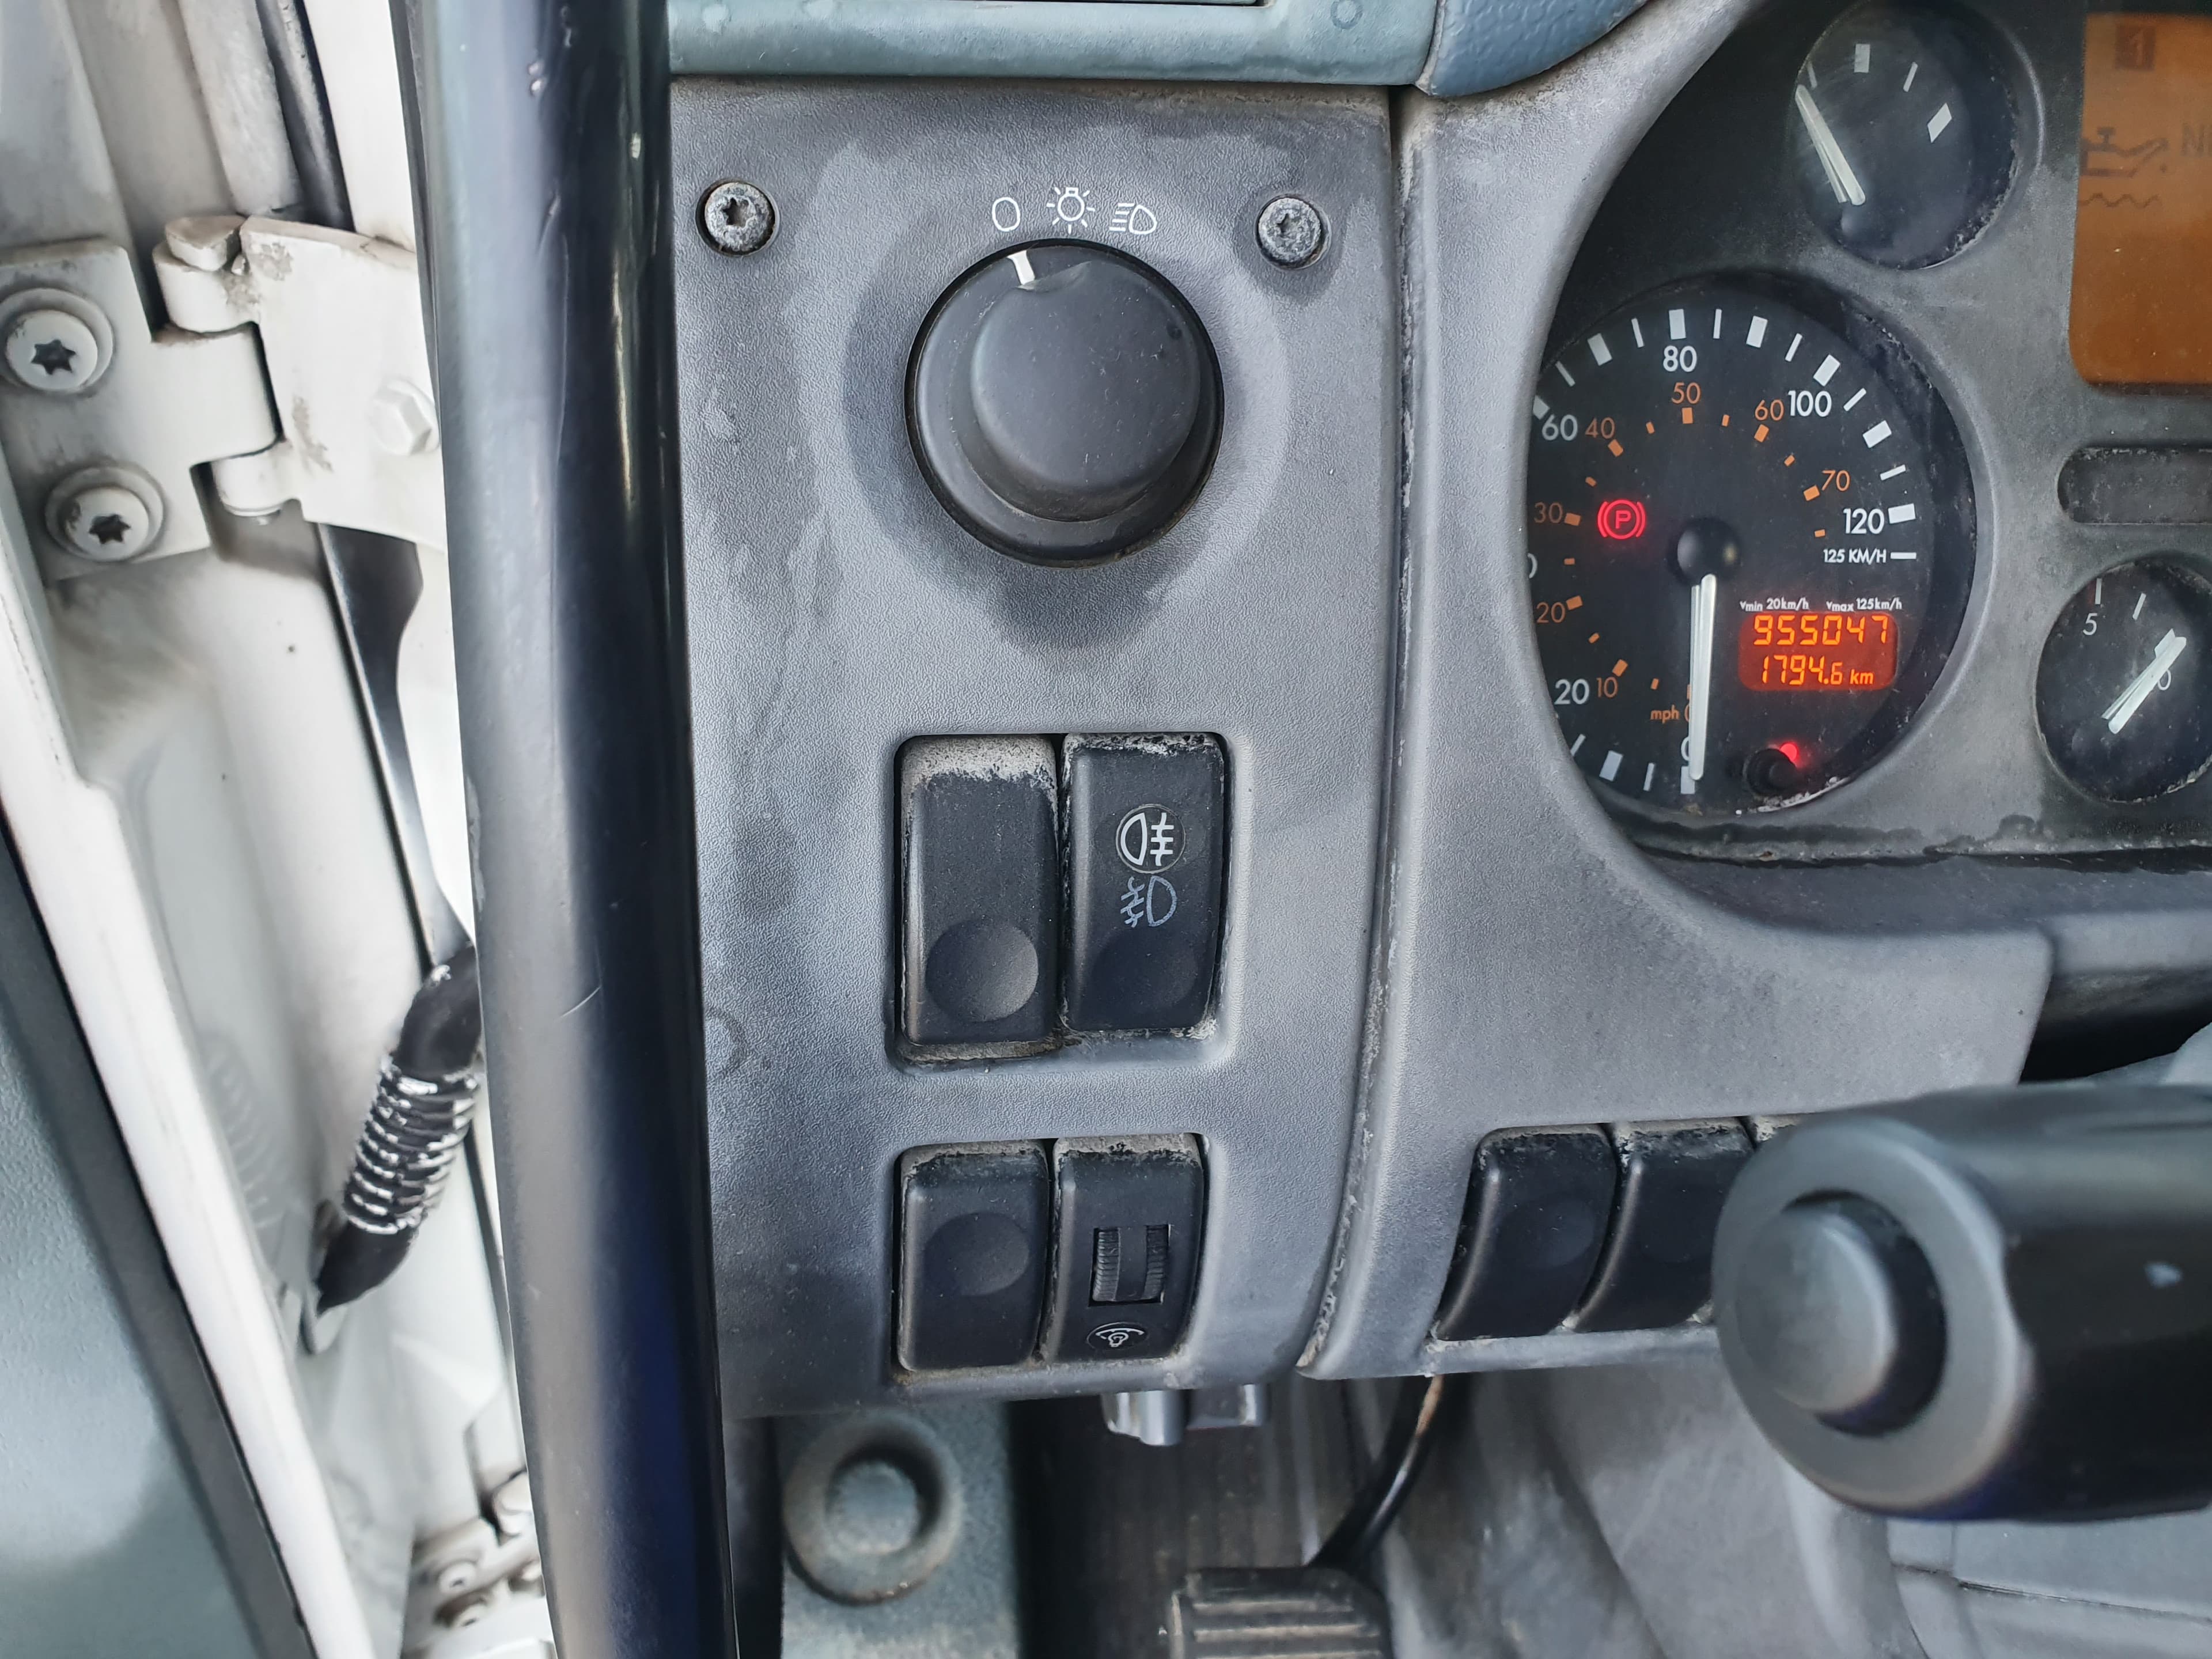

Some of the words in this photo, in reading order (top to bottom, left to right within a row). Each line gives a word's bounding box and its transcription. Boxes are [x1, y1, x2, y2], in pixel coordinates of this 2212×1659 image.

[1663, 345, 1697, 372] 80
[1671, 382, 1701, 404] 50
[1788, 390, 1832, 417] 100
[1755, 399, 1785, 421] 60
[1541, 414, 1578, 441] 60
[1585, 417, 1615, 439] 40
[1821, 470, 1850, 491] 70
[1534, 502, 1563, 524] 30
[1843, 508, 1884, 534] 120
[1823, 548, 1846, 563] 125
[1849, 548, 1887, 565] KM/H
[1536, 602, 1566, 623] 20
[1753, 615, 1888, 645] 955047
[2082, 613, 2097, 635] 5
[1762, 654, 1843, 685] 1794.6
[1850, 669, 1874, 684] km
[1554, 679, 1590, 704] 20
[1597, 678, 1618, 698] 10
[1650, 704, 1680, 724] mph
